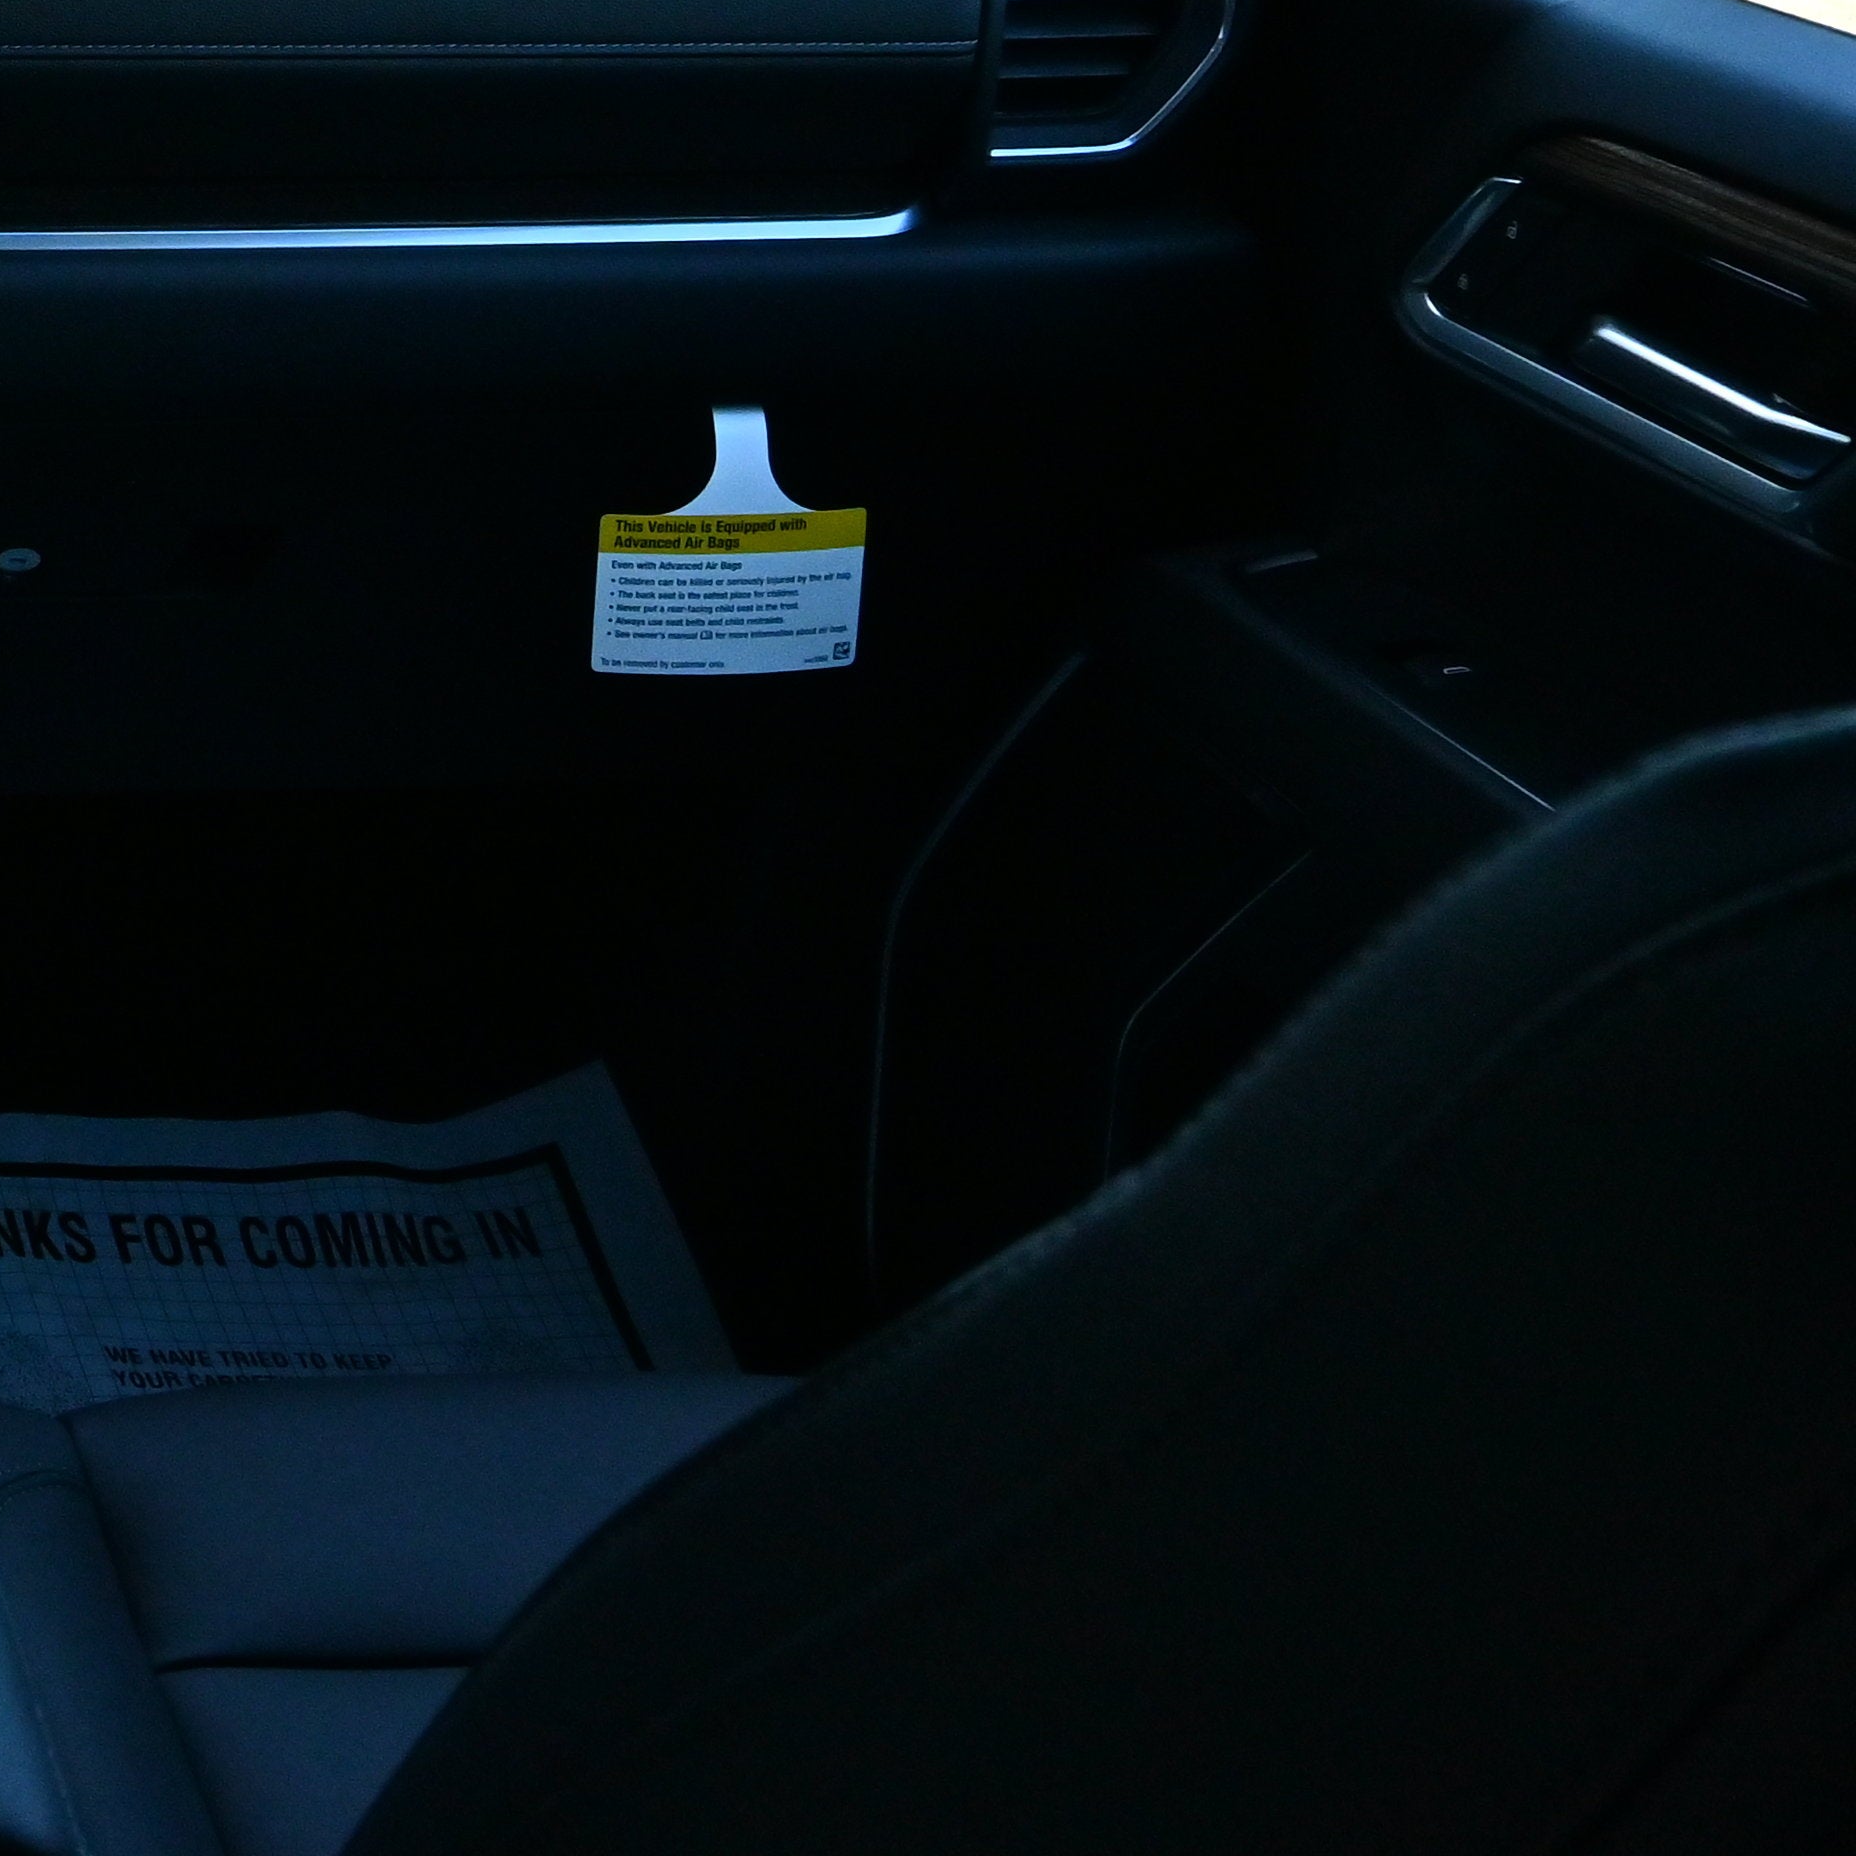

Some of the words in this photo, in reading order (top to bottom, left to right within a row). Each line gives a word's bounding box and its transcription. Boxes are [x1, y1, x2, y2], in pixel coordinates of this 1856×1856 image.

[616, 520, 643, 533] This
[649, 520, 696, 533] Vehicle
[716, 520, 776, 535] Equipped
[780, 518, 807, 531] with
[615, 535, 680, 549] Advanced
[685, 535, 703, 548] Air
[708, 536, 740, 551] Bags
[612, 561, 634, 569] Even
[659, 561, 703, 570] Advanced
[705, 561, 718, 570] Air
[721, 561, 743, 572] Bags
[108, 1213, 227, 1268] FOR
[239, 1212, 467, 1269] COMING
[474, 1208, 542, 1259] IN
[104, 1344, 144, 1366] WE
[149, 1347, 215, 1367] HAVE
[216, 1349, 289, 1369] TRIED
[294, 1351, 326, 1370] TO
[331, 1352, 393, 1371] KEEP
[112, 1369, 182, 1388] YOUR
